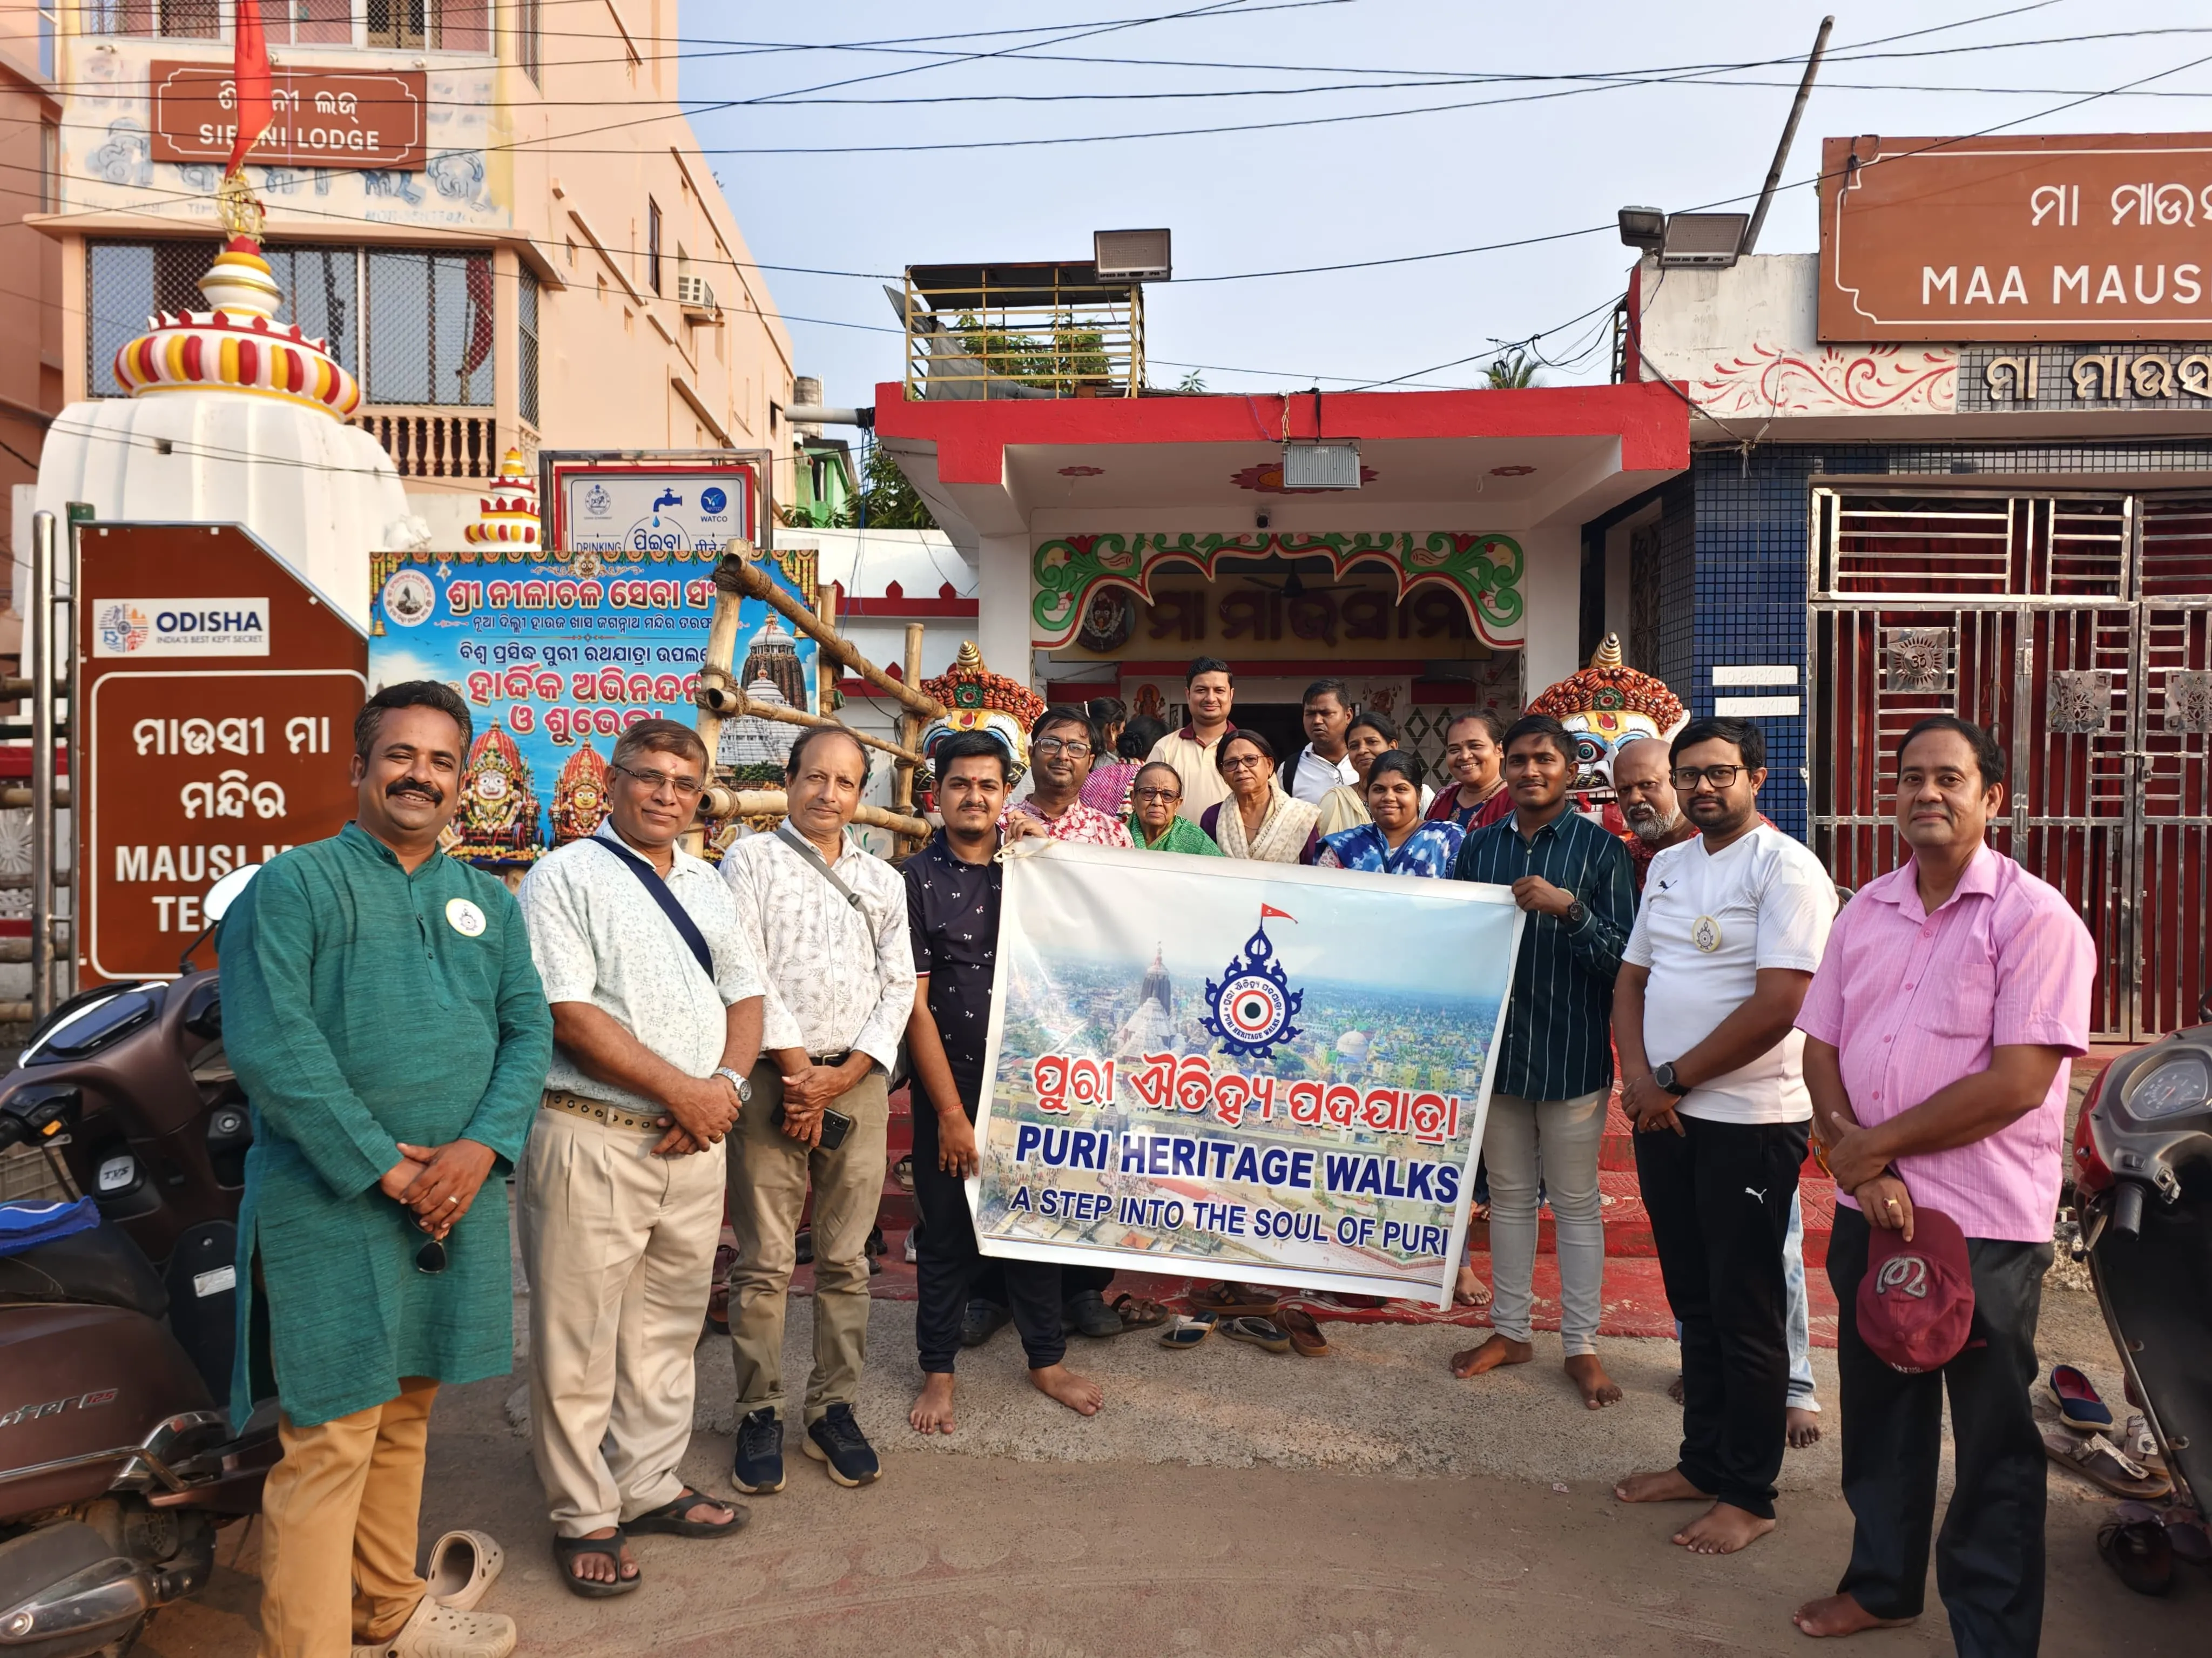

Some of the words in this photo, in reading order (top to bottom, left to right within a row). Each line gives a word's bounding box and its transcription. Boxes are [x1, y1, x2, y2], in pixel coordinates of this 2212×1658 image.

[199, 124, 286, 147] SIBNI
[298, 127, 379, 151] LODGE
[2031, 184, 2079, 226] ମା
[2111, 182, 2212, 227] ମାଉ
[1922, 265, 2029, 305] MAA
[2052, 264, 2212, 305] MAUS
[1986, 356, 2038, 400] ମା
[576, 542, 622, 551] DRINKING
[685, 580, 717, 610] ସଂ
[156, 611, 263, 632] ODISHA
[679, 617, 713, 629] ତରଫ
[190, 635, 210, 643] BEST
[212, 635, 231, 643] KEPT
[133, 717, 265, 756] ମାଉସୀ
[285, 717, 329, 754] ମା
[180, 770, 287, 819] ମନ୍ଦିର
[1224, 1013, 1235, 1029] PURI
[1232, 1027, 1263, 1040] HERITAGE
[1263, 1019, 1280, 1036] WALKS
[1034, 1055, 1115, 1111] ପୁରୀ
[1130, 1053, 1274, 1125] ଐତିହ୍ୟ
[1289, 1082, 1458, 1142] ପଦଯାତ୍ରା
[103, 1165, 130, 1181] TVS
[1016, 1125, 1109, 1170] PURI
[1121, 1135, 1315, 1188] HERITAGE
[1326, 1155, 1459, 1203] WALKS
[1010, 1186, 1031, 1211] A
[1040, 1189, 1112, 1221] STEP
[1119, 1197, 1184, 1229] INTO
[1193, 1202, 1246, 1235] THE
[1254, 1208, 1328, 1241] SOUL
[1337, 1216, 1375, 1246] OF
[1382, 1221, 1448, 1257] PURI
[87, 1392, 116, 1404] 125
